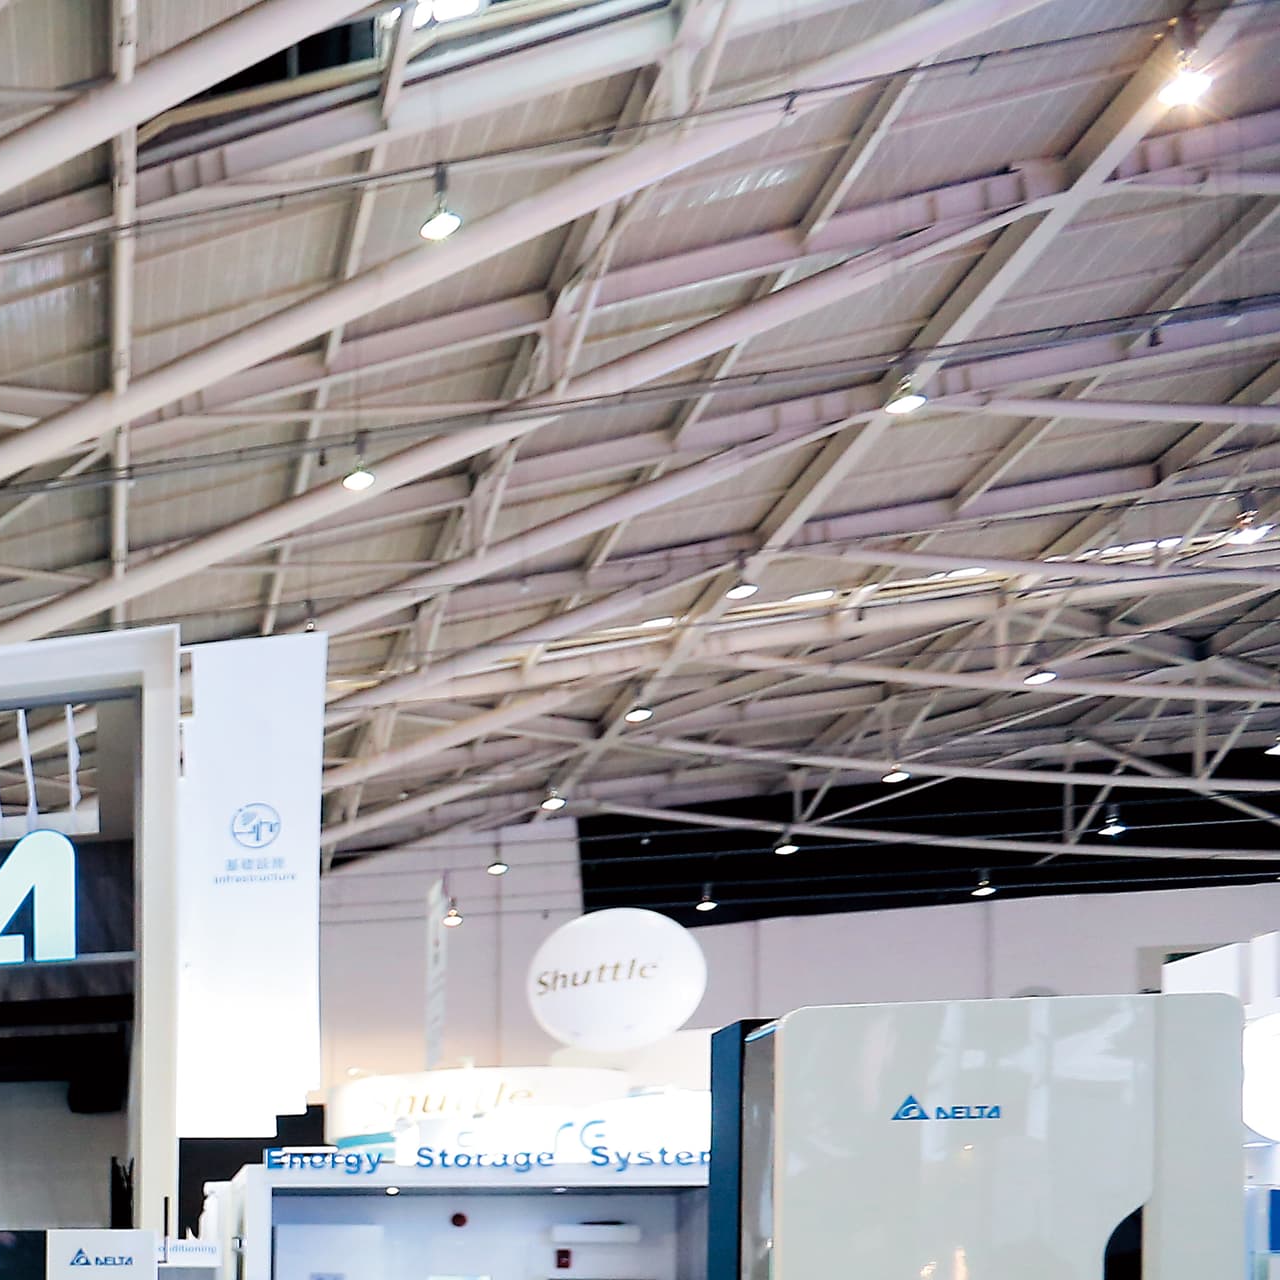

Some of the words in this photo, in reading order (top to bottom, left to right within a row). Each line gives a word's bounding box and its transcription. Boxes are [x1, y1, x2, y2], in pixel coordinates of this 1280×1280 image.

[536, 958, 658, 996] Shuttle
[935, 1104, 1001, 1120] DELTA
[416, 1147, 554, 1173] Storage
[95, 1256, 134, 1266] DELTA
